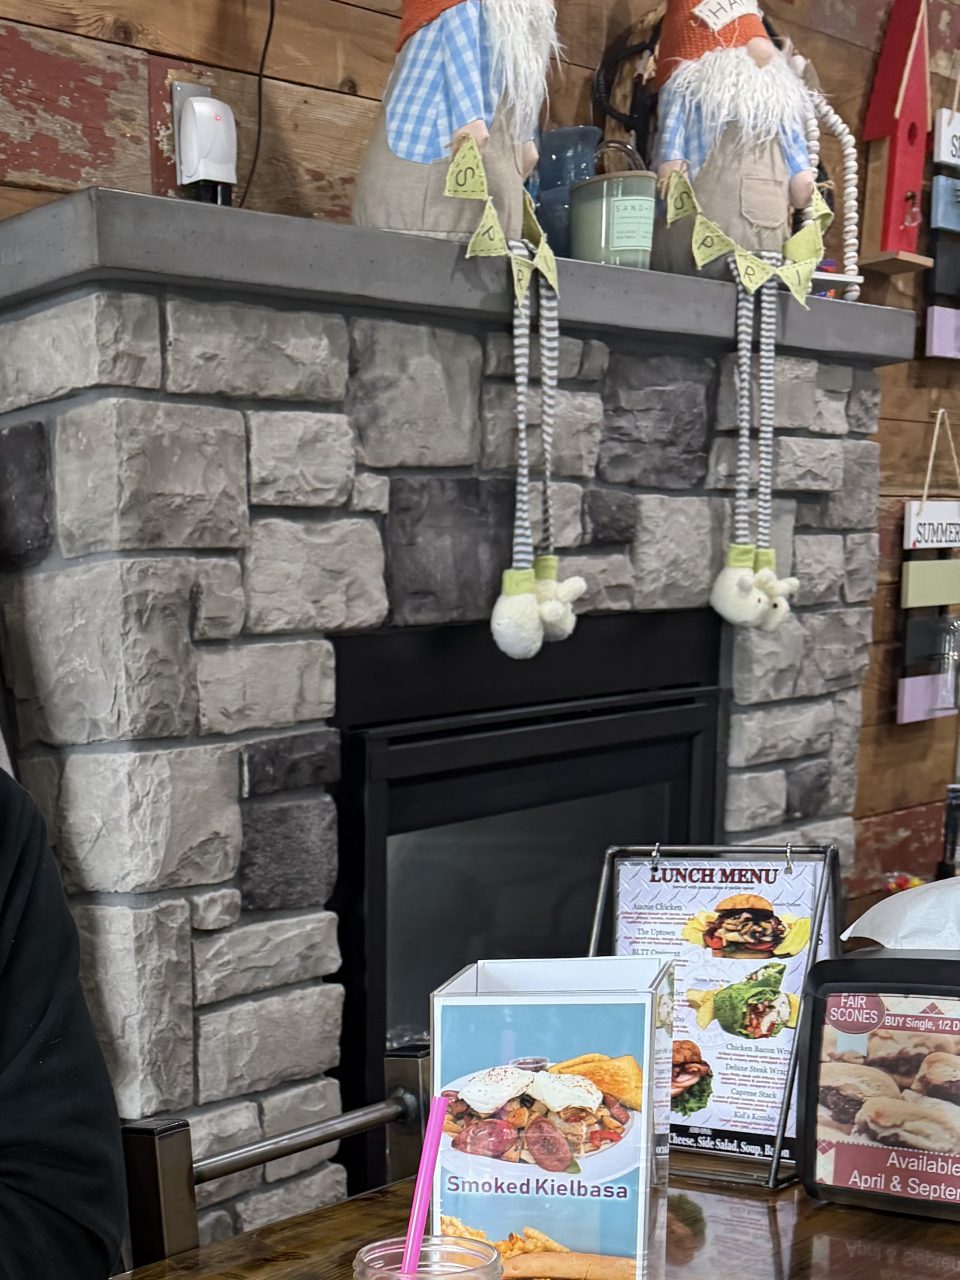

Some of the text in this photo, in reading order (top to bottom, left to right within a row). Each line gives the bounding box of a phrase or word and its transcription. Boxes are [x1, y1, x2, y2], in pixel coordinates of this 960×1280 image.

[650, 868, 779, 884] LUNCH MENU
[840, 993, 867, 1009] FAIR
[830, 1007, 878, 1024] SCONES
[884, 1016, 904, 1026] BUY
[906, 1017, 936, 1031] Single,
[726, 1043, 753, 1052] Chicken
[725, 1063, 748, 1072] Deluxe
[749, 1066, 768, 1074] Steak
[731, 1088, 777, 1099] Caprese Stack
[668, 1133, 696, 1147] Cheese,
[697, 1136, 714, 1149] Side
[715, 1138, 739, 1152] Salad,
[740, 1142, 763, 1157] Soup,
[887, 1152, 960, 1177] Available
[447, 1176, 628, 1199] Smoked Kielbasa
[848, 1170, 885, 1190] April
[890, 1176, 902, 1192] &
